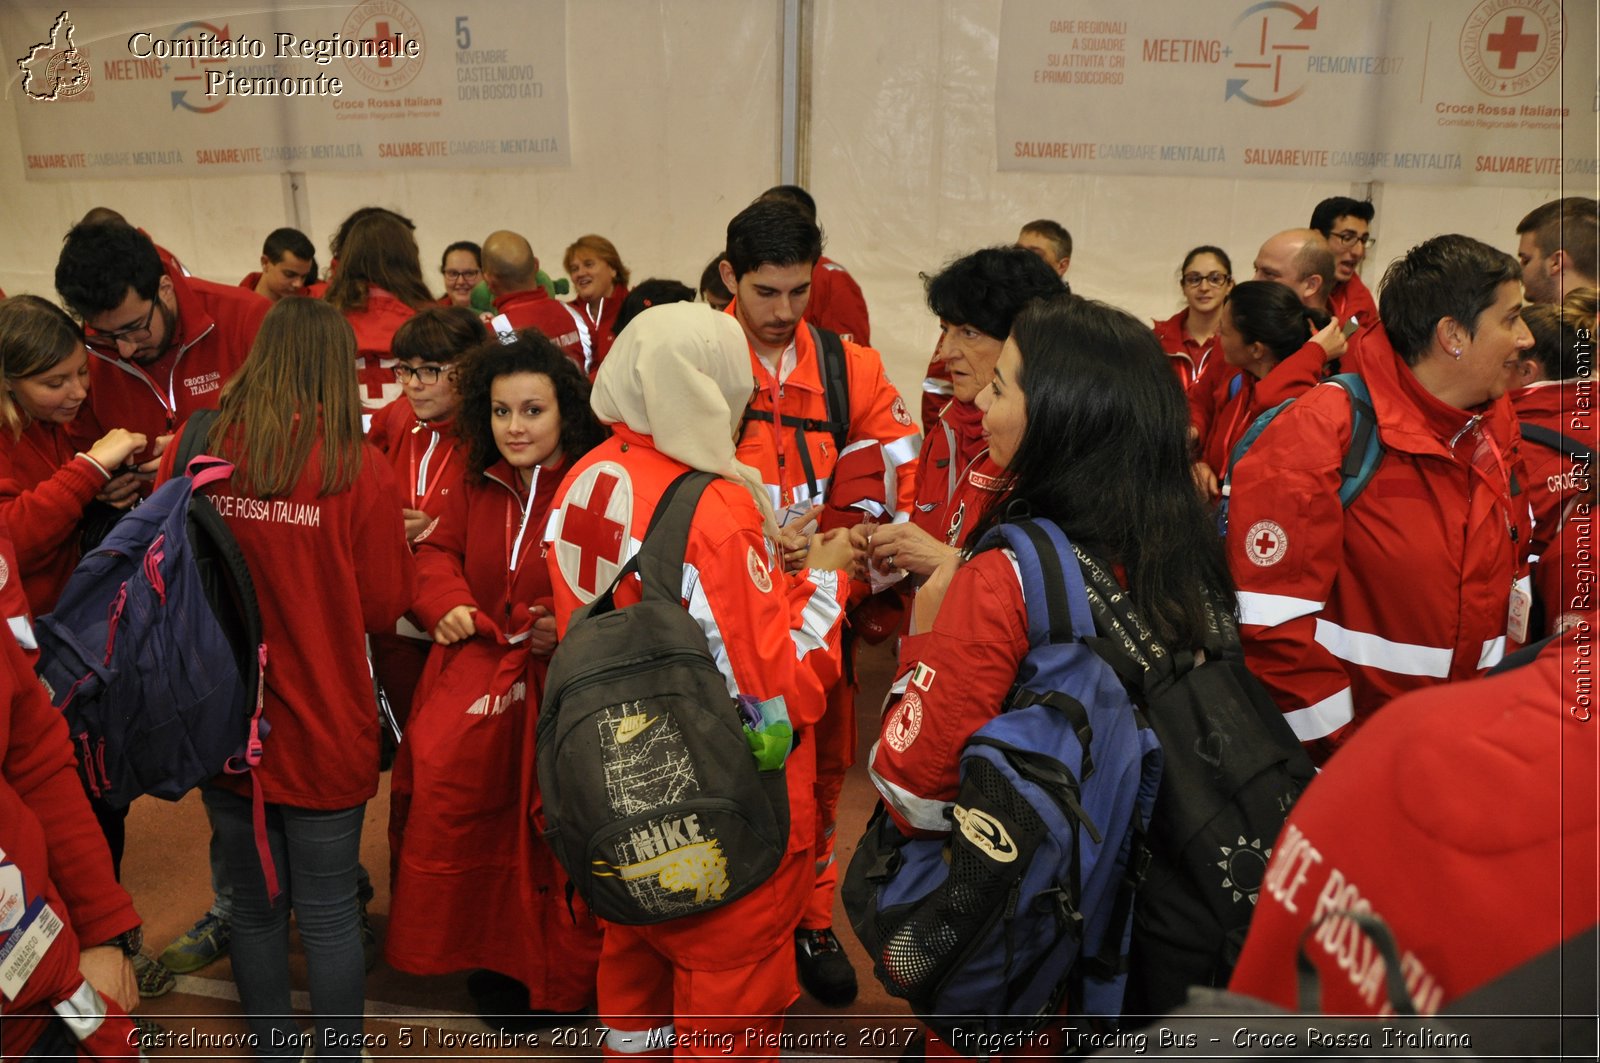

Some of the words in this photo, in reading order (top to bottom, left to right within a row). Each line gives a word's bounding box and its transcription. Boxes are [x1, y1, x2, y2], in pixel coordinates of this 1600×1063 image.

[455, 16, 471, 49] 5
[1050, 20, 1075, 33] GARE
[1077, 21, 1127, 34] REGIONALI
[1072, 38, 1079, 50] A
[1081, 38, 1125, 51] SQUADRE
[455, 50, 508, 65] NOVEMBRE
[1047, 54, 1060, 66] SU
[1109, 56, 1125, 69] CRI
[457, 65, 533, 83] CASTELNUOVO
[1034, 71, 1040, 83] E
[1042, 71, 1072, 84] PRIMO
[1074, 72, 1124, 85] SOCCORSO
[458, 85, 480, 100] DON
[482, 84, 517, 100] BOSCO
[332, 99, 364, 110] Croce
[367, 98, 401, 109] Rossa
[404, 97, 442, 107] Italiana
[1436, 103, 1474, 114] Croce
[1477, 104, 1516, 115] Rossa
[1520, 105, 1570, 117] Italiana
[263, 146, 309, 161] CAMBIARE
[450, 140, 498, 155] CAMBIARE
[1099, 144, 1157, 161] CAMBIARE
[1331, 150, 1390, 168] CAMBIARE
[184, 375, 206, 387] CROCE
[190, 381, 219, 396] ITALIANA
[236, 498, 269, 521] ROSSA
[272, 501, 320, 527] ITALIANA
[621, 714, 647, 733] NIKE
[631, 813, 705, 862] NIKE
[4, 936, 39, 981] GIANMARCO
